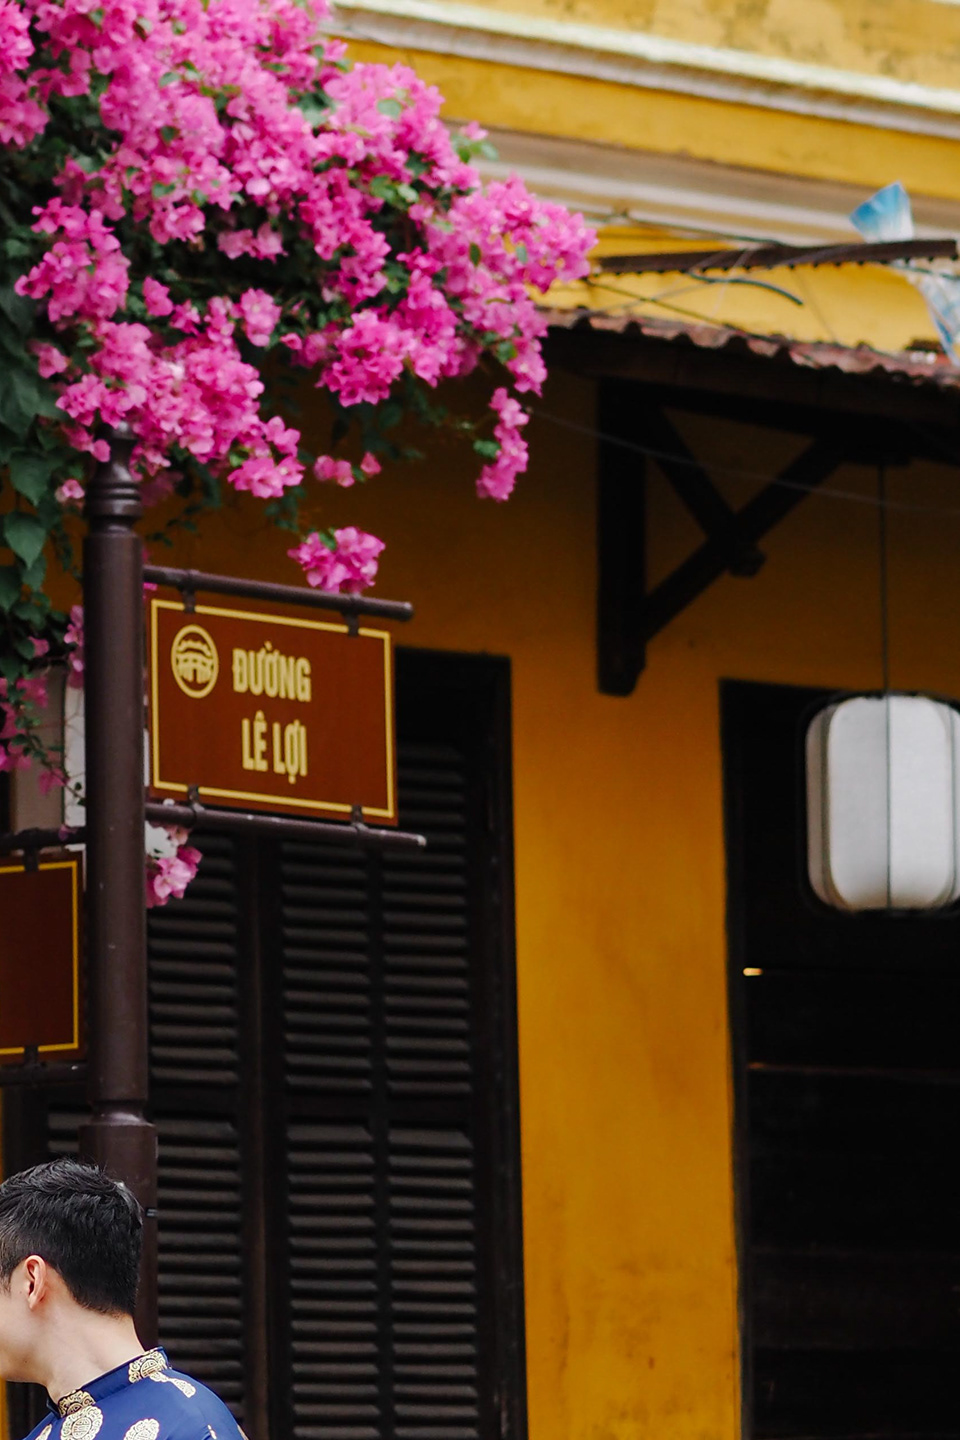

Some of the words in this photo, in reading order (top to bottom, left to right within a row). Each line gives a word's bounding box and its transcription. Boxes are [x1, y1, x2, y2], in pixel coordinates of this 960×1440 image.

[231, 640, 312, 702] ĐƯỜNG
[241, 709, 269, 773] LÊ
[272, 718, 308, 785] LỢI
